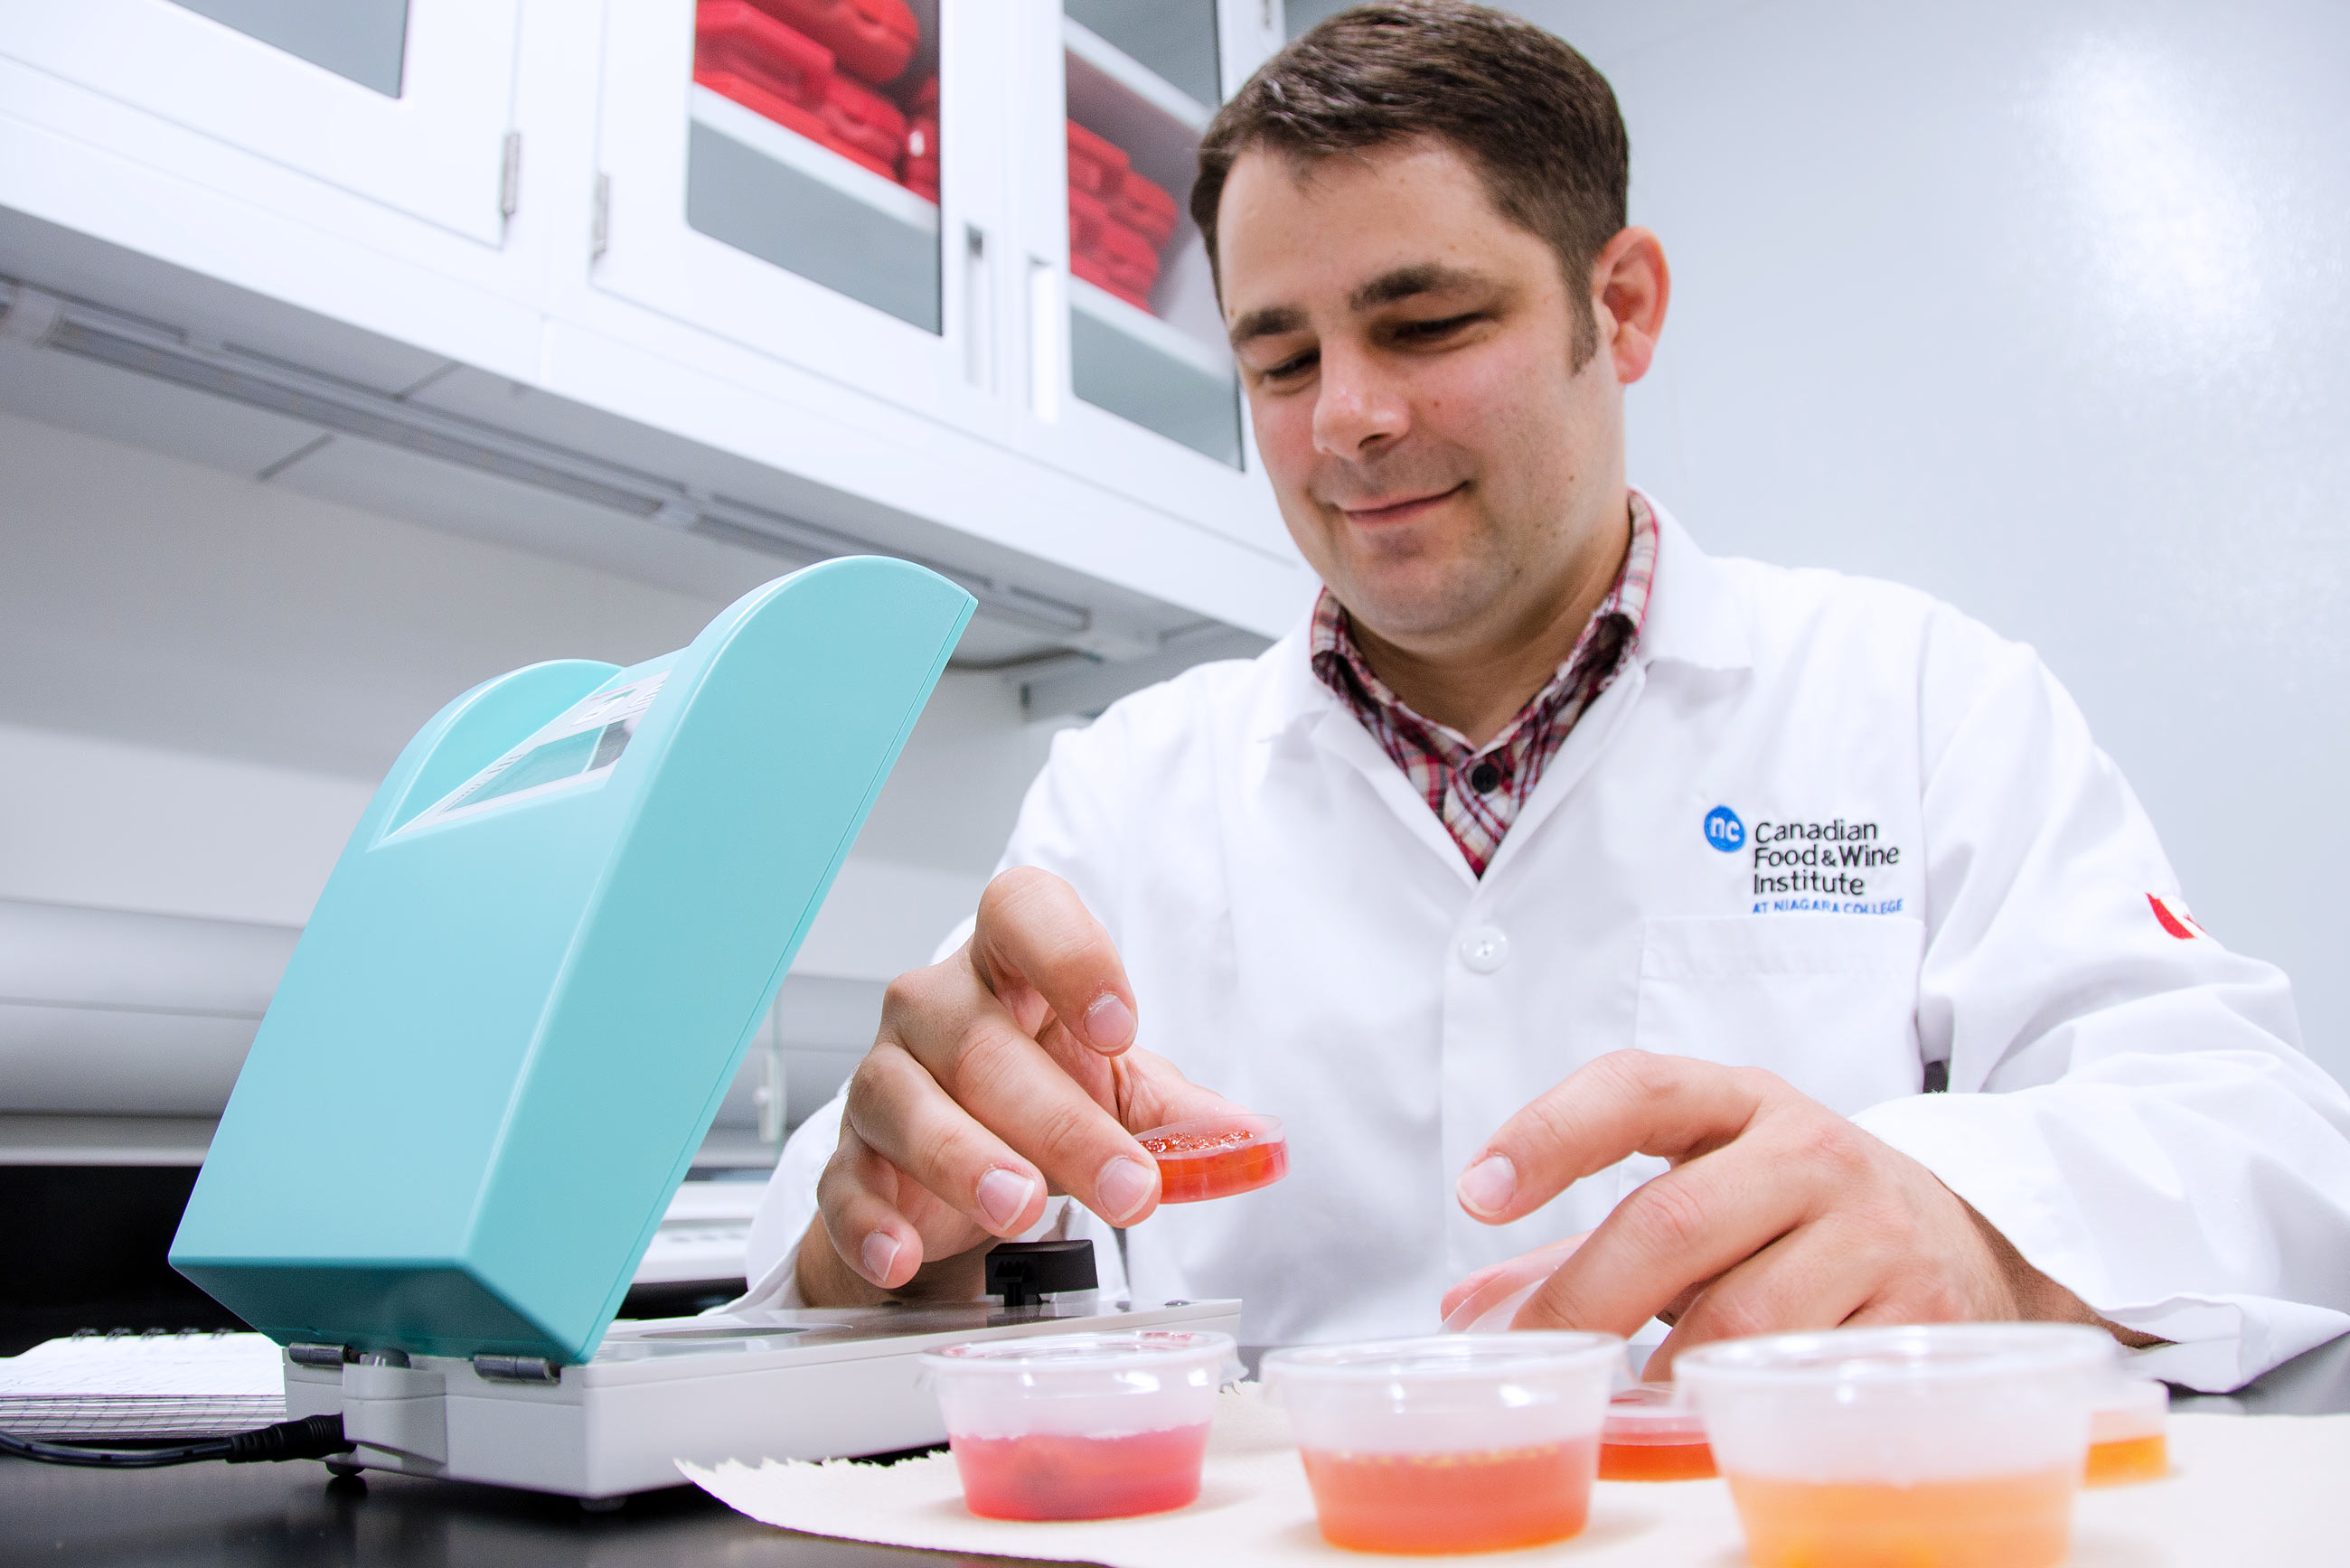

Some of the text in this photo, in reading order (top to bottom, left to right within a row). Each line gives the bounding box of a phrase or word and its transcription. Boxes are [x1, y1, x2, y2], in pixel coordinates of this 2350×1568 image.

[1710, 817, 1740, 842] nc
[1755, 820, 1878, 844] Canadian
[1753, 869, 1866, 896] Institute
[1753, 898, 1904, 915] AT NIAGARA COLLEGE
